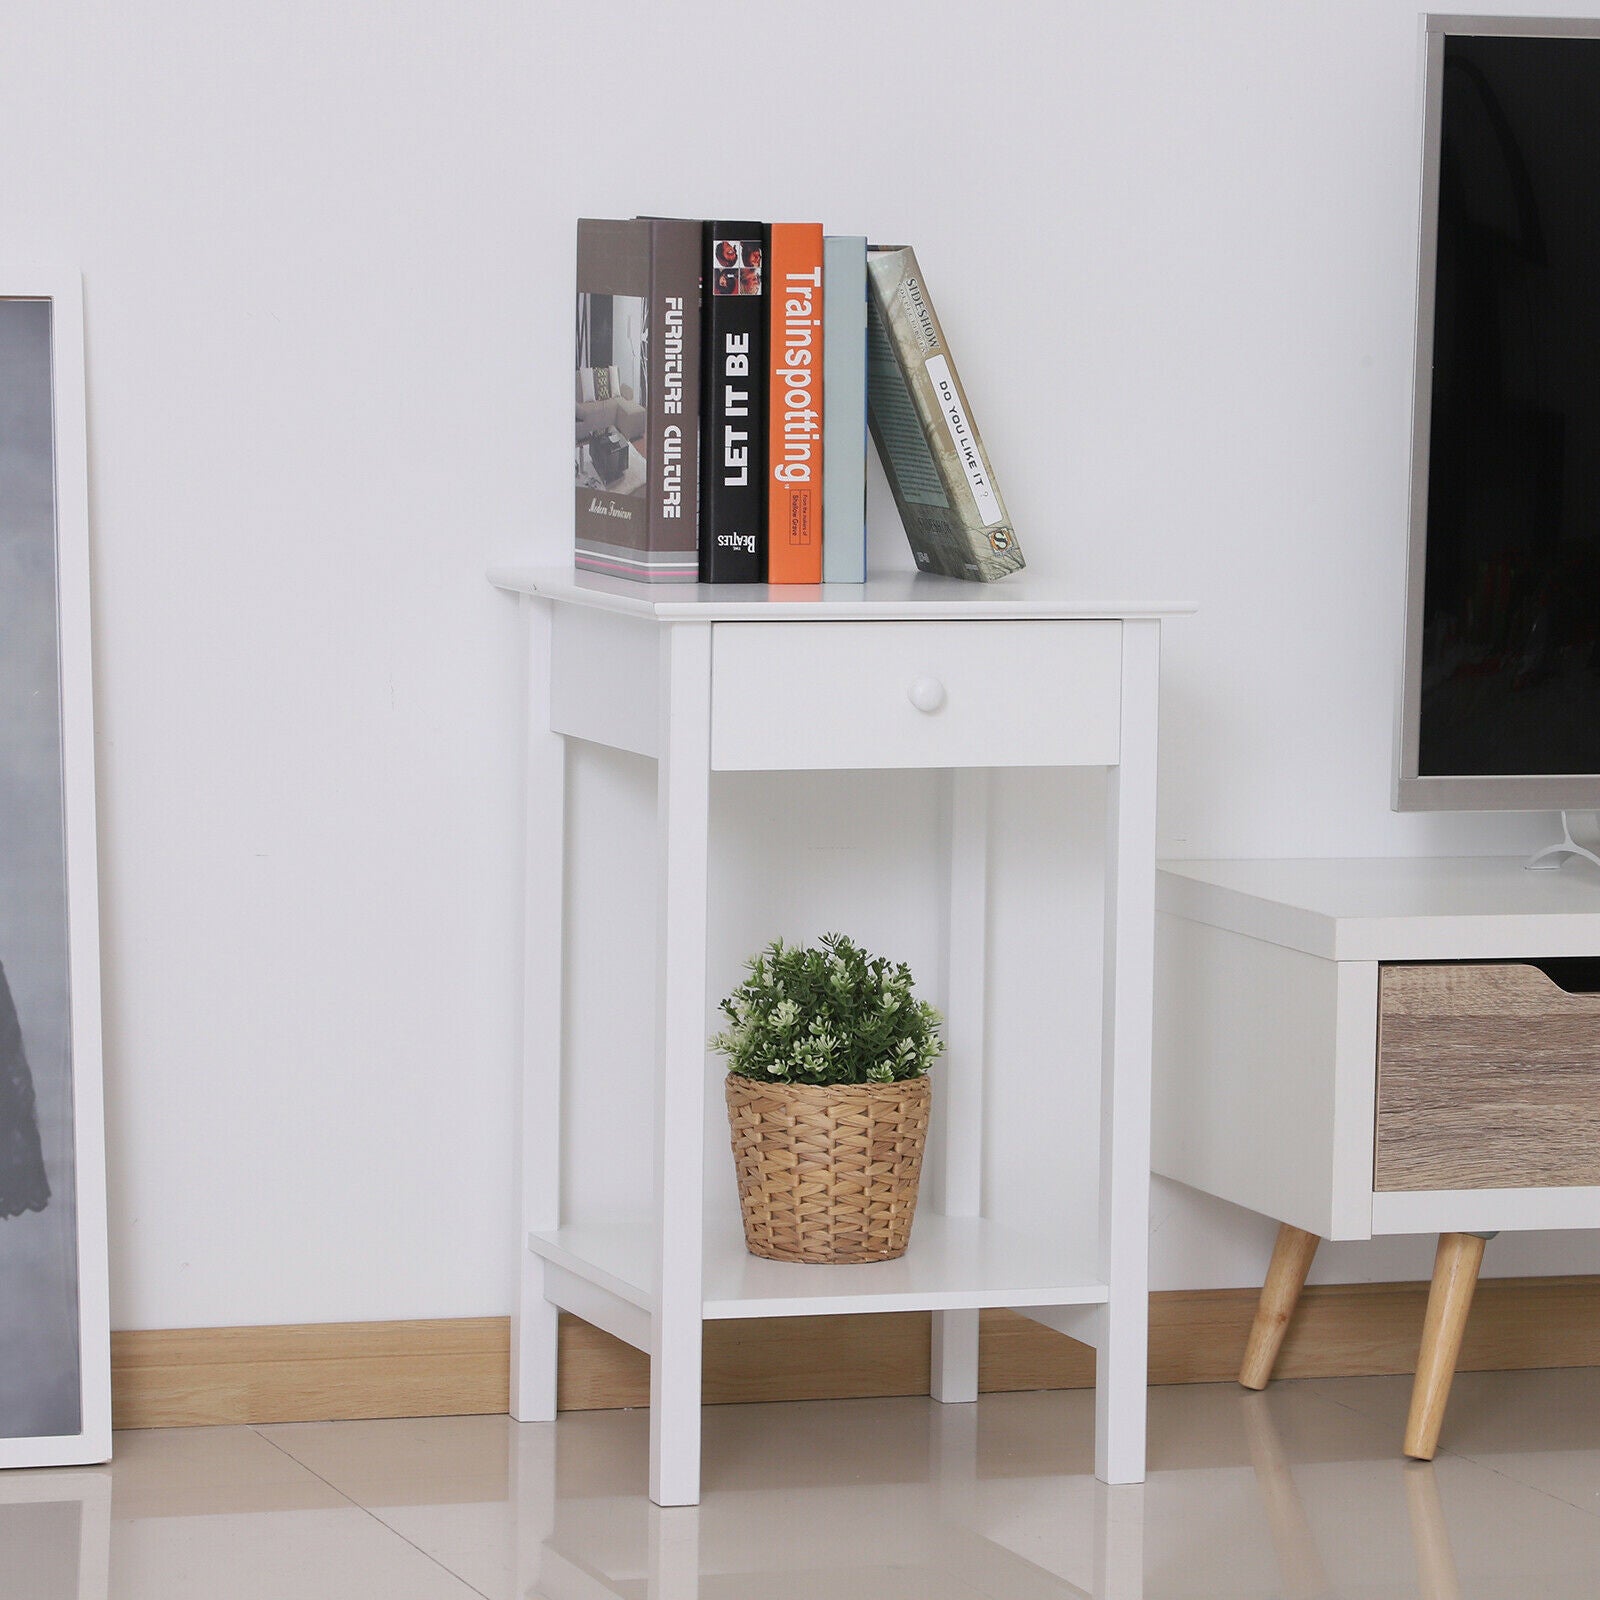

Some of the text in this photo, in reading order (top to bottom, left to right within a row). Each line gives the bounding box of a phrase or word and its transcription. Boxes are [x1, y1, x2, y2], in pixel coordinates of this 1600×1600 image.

[774, 266, 821, 482] Trainspotting
[906, 278, 940, 348] SIDESHOW
[663, 297, 682, 518] FURNITURE CULTURE
[725, 333, 749, 486] LET IT BE
[939, 381, 951, 401] DO
[949, 405, 964, 434] YOU
[960, 438, 977, 469] LIKE
[973, 472, 984, 487] IT
